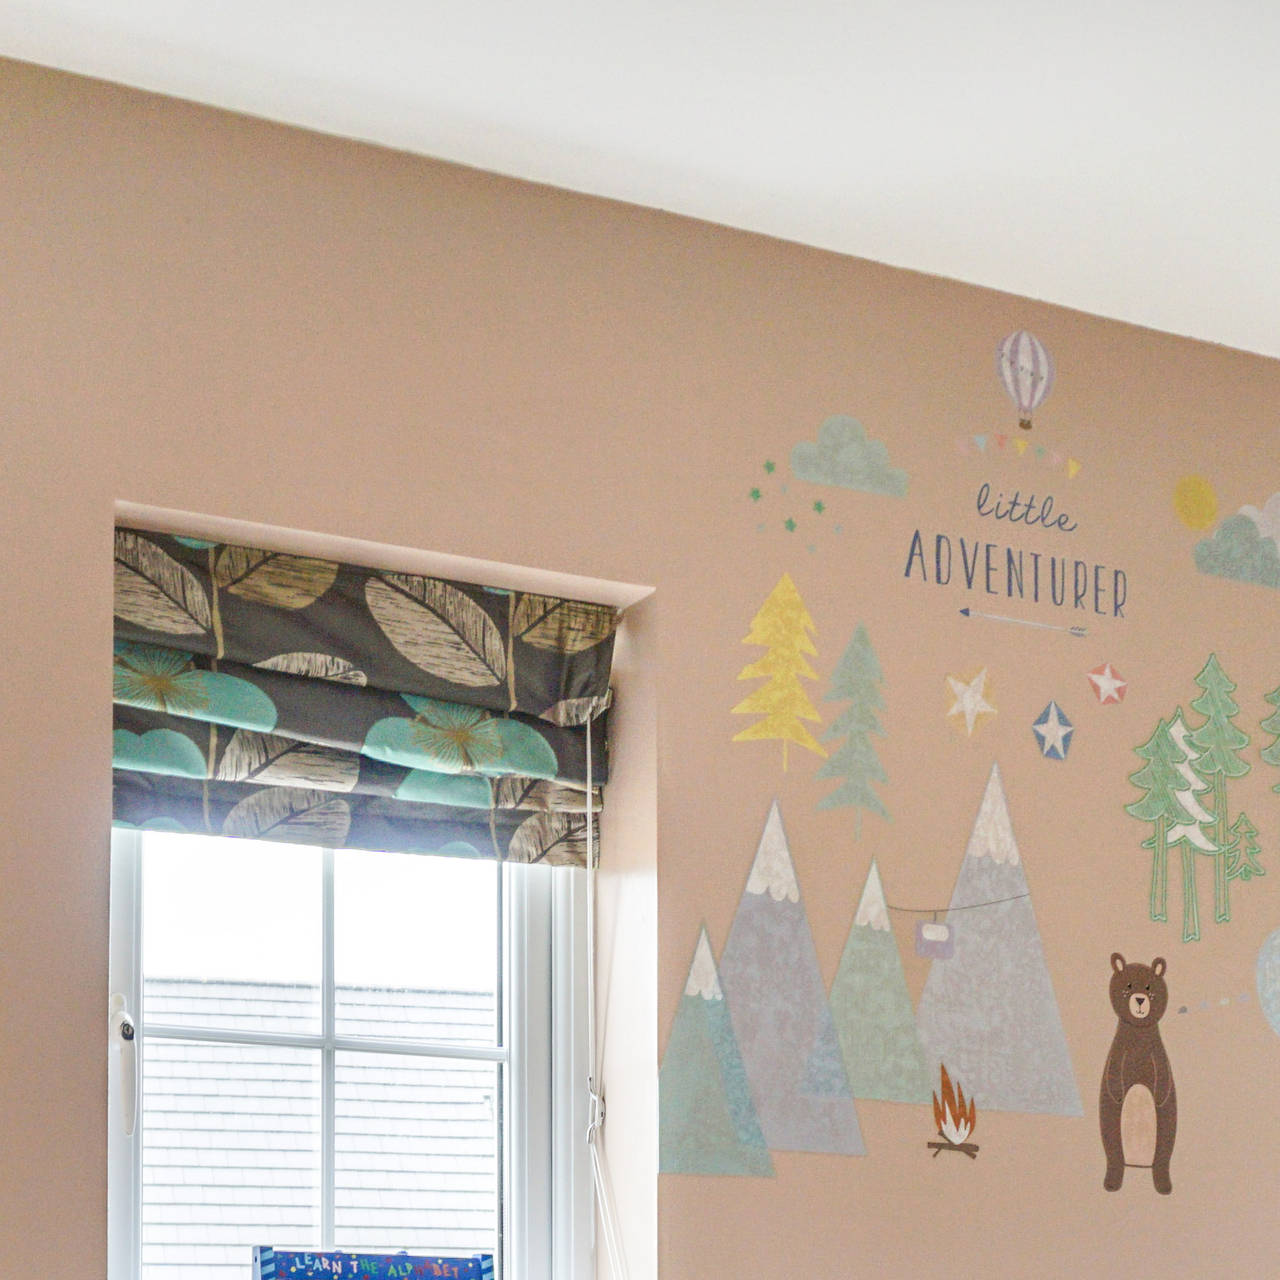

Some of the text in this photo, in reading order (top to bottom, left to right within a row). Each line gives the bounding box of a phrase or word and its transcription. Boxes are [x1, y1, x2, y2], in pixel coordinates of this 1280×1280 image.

[976, 482, 1078, 532] little
[903, 529, 1128, 618] ADVENTURER
[295, 1254, 459, 1278] LEARN THE ALPHABET
